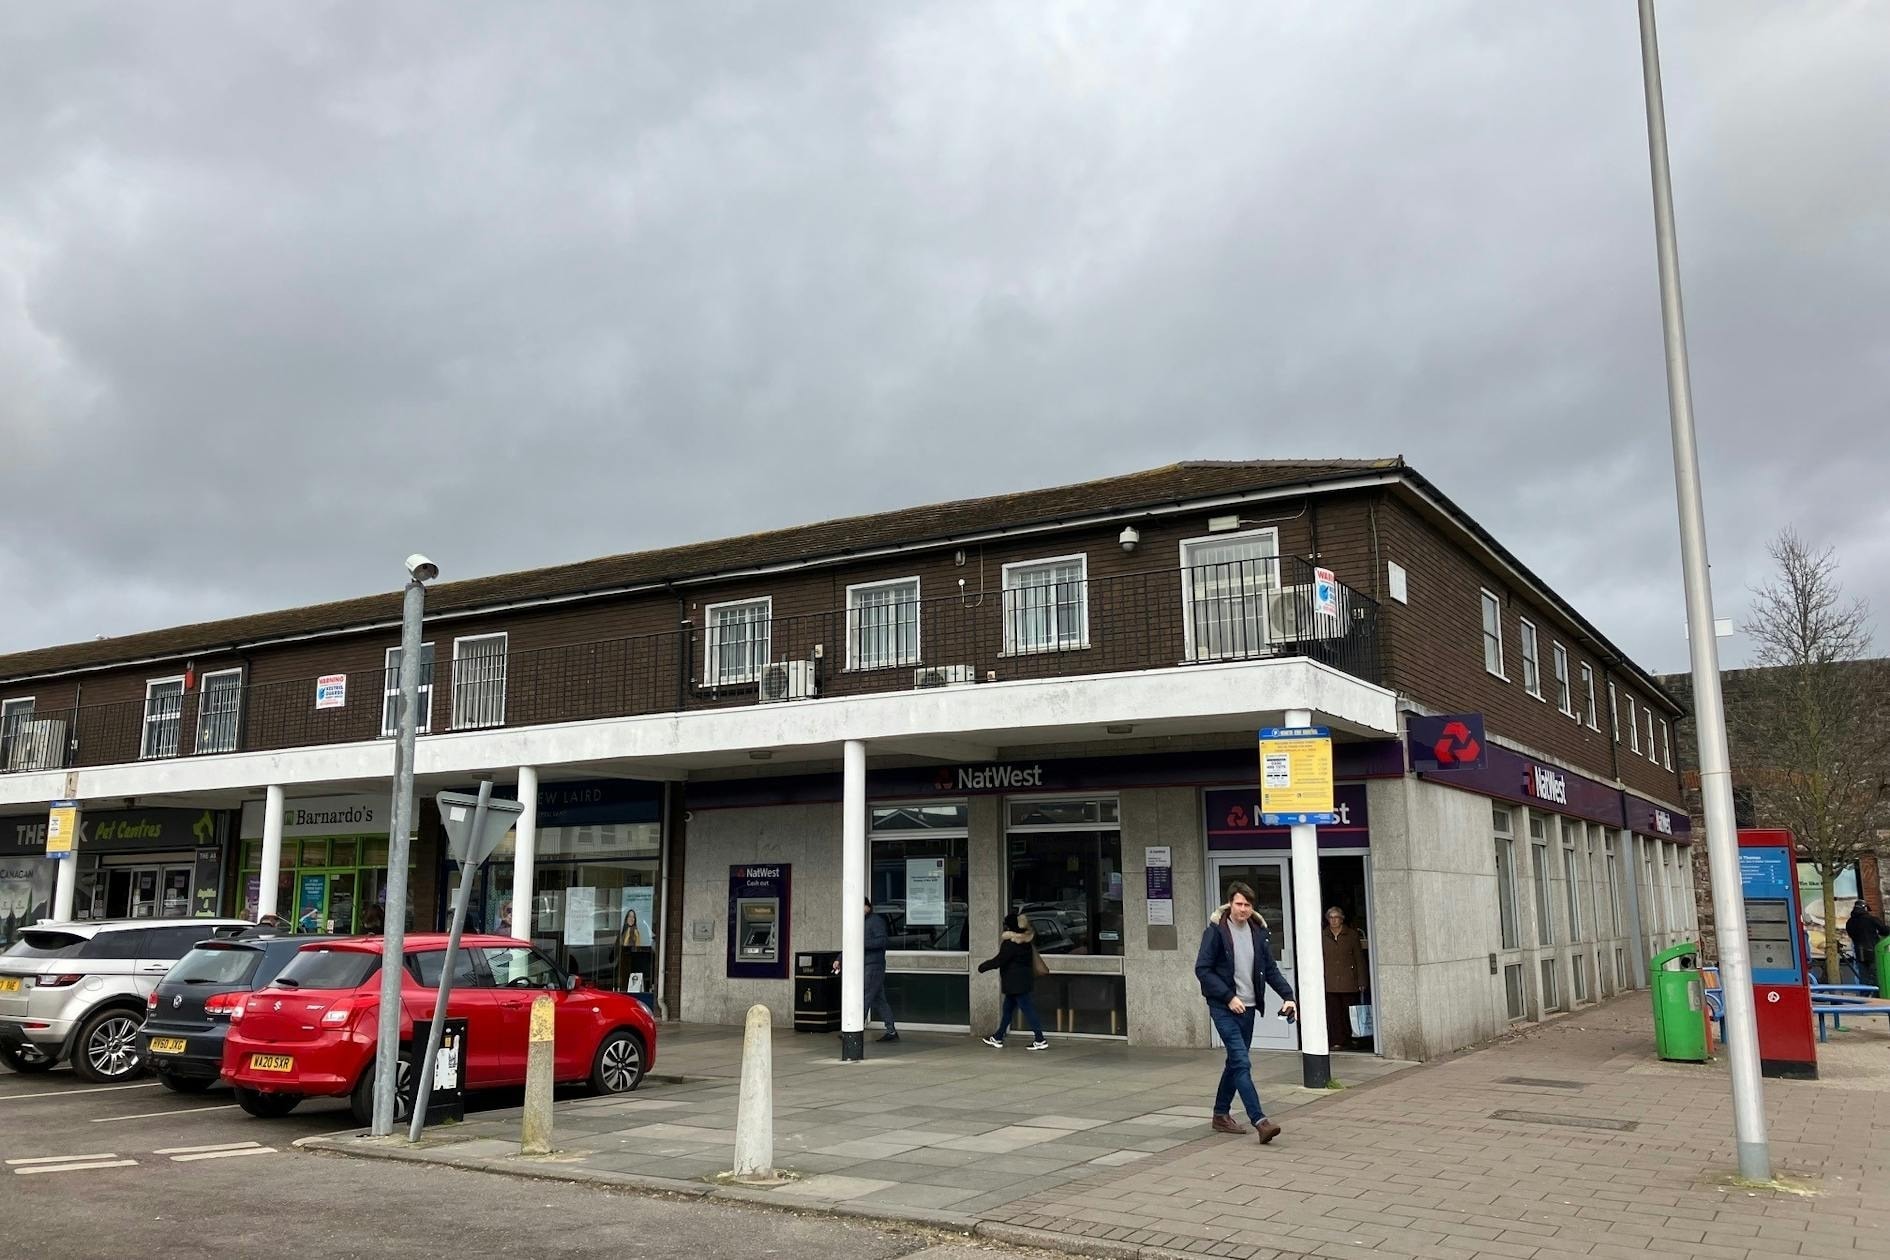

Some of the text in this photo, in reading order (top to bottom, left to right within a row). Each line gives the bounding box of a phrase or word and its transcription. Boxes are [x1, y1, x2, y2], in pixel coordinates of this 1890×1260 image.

[958, 765, 1042, 790] NatWest
[1534, 765, 1567, 805] NatWest
[563, 789, 601, 804] LAIRD
[295, 805, 373, 825] Barnardo's
[16, 823, 46, 846] THE
[95, 821, 116, 841] Pet
[117, 819, 162, 839] Centres
[746, 867, 780, 878] NatWest
[253, 1055, 290, 1070] WA20 SXR
